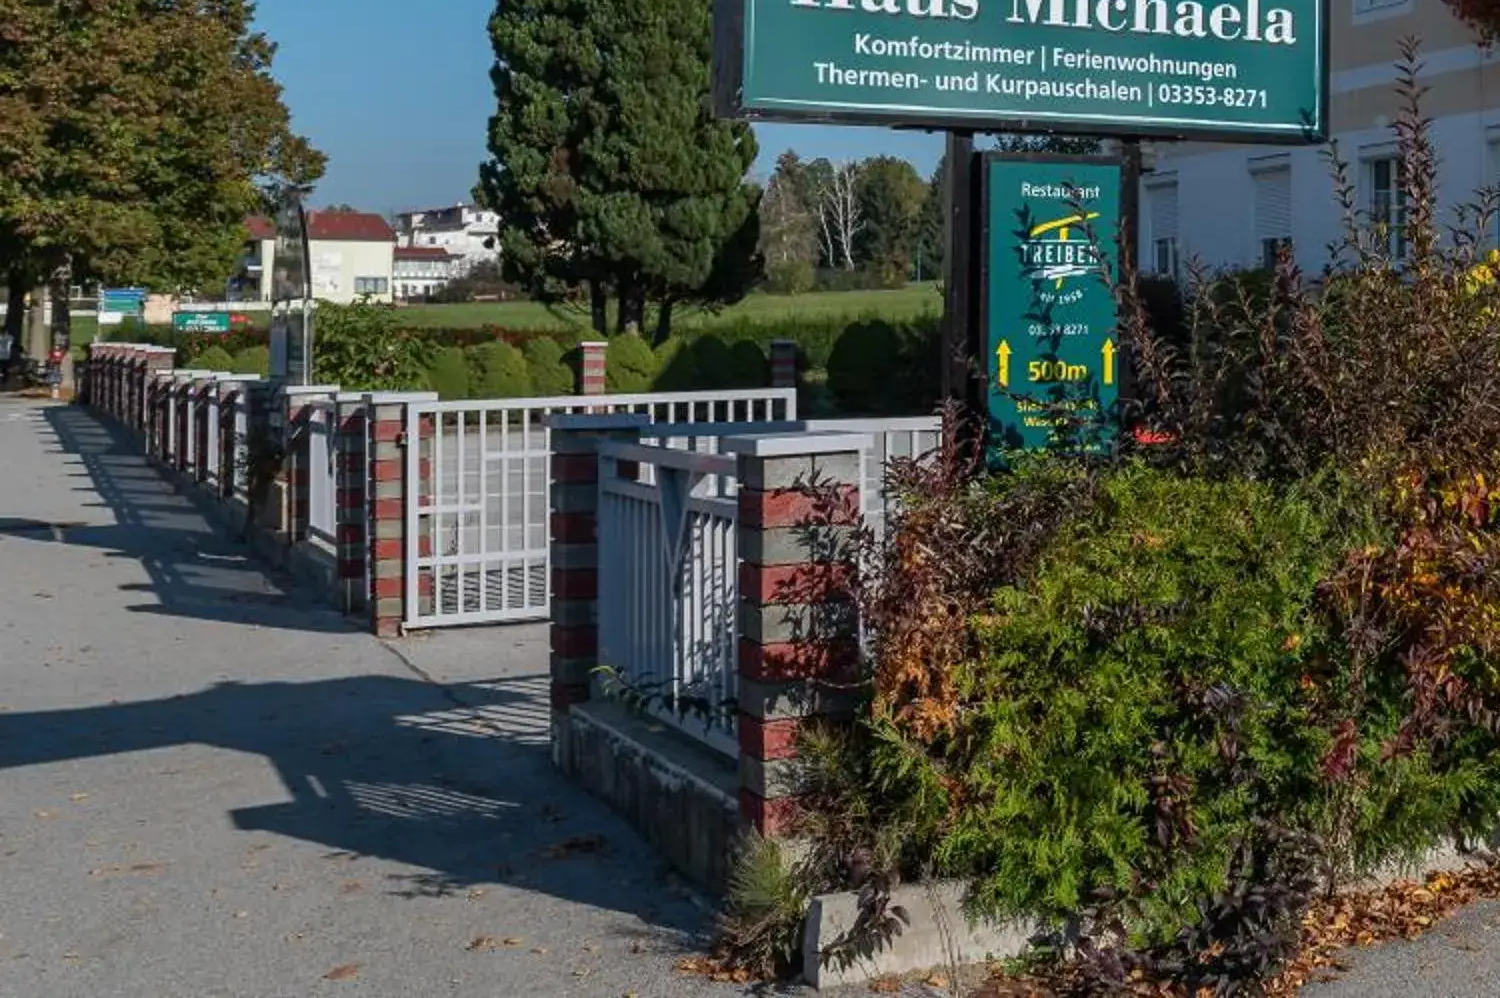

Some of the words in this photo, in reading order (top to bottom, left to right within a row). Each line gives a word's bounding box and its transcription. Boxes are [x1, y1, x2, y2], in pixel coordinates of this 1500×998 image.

[854, 33, 1036, 65] Komfortzimmer
[1052, 47, 1238, 81] Ferienwohnungen
[813, 62, 928, 89] Thermen-
[934, 71, 978, 93] und
[985, 73, 1142, 102] Kurpauschalen
[1158, 83, 1268, 108] 03353-8271
[1027, 360, 1088, 382] 500m
